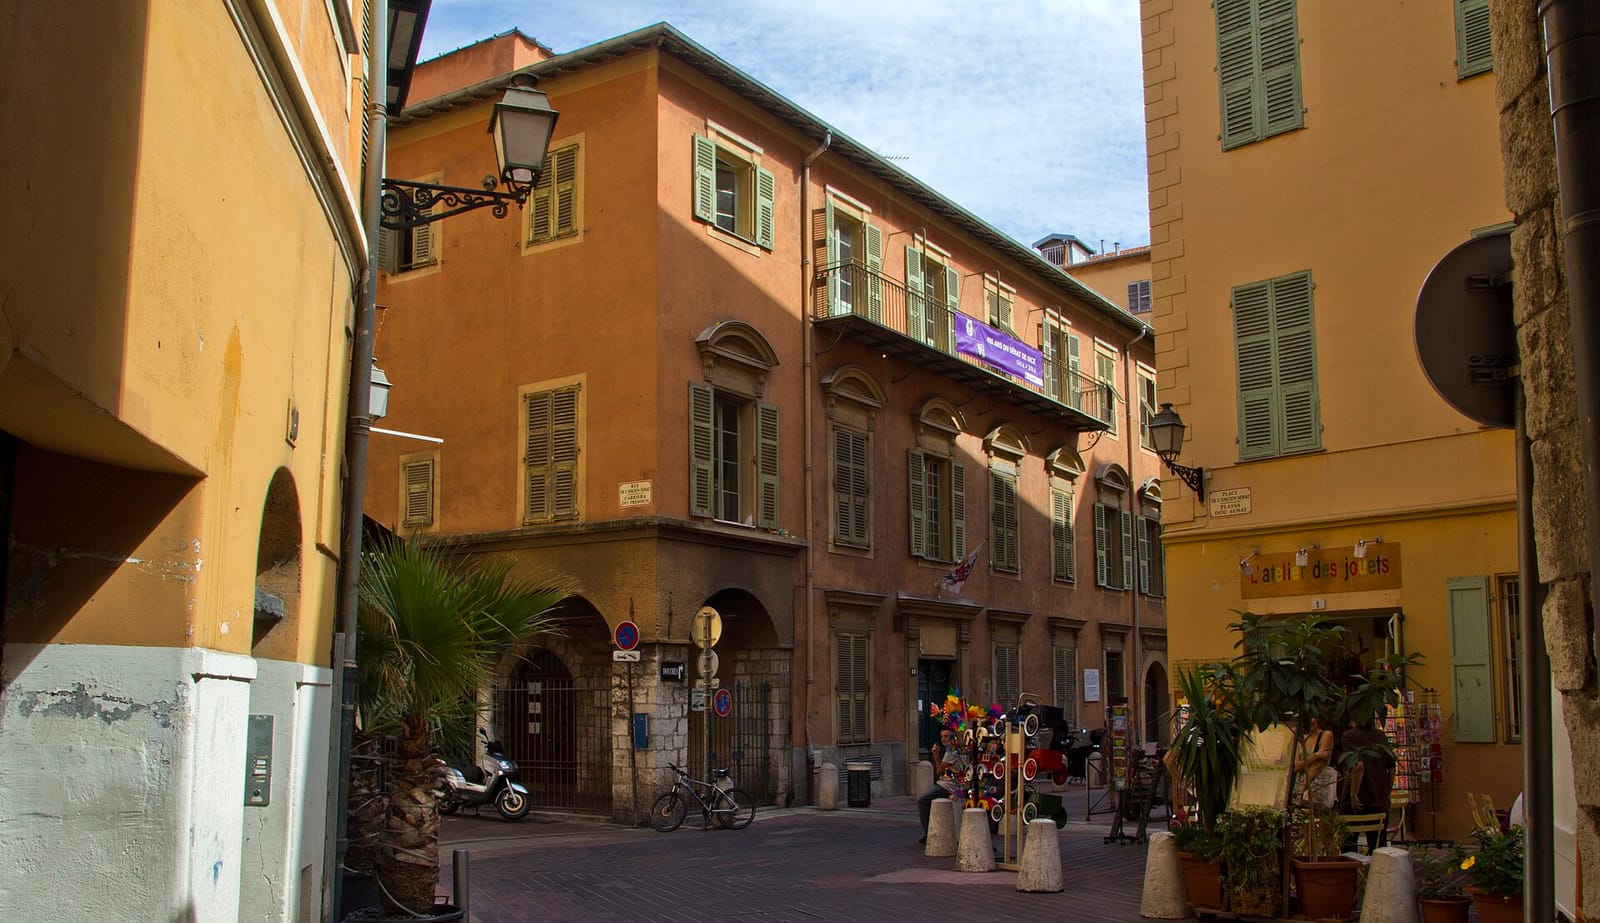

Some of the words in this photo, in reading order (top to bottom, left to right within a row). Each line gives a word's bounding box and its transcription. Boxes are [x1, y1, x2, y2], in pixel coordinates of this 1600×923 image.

[994, 340, 1003, 350] ANS
[1003, 343, 1009, 352] DU
[1021, 352, 1027, 361] DE
[1027, 355, 1036, 365] NICE
[1220, 502, 1241, 510] PLASSA
[1251, 561, 1306, 584] L'atelier
[1312, 559, 1338, 580] des
[1343, 555, 1390, 582] jouets
